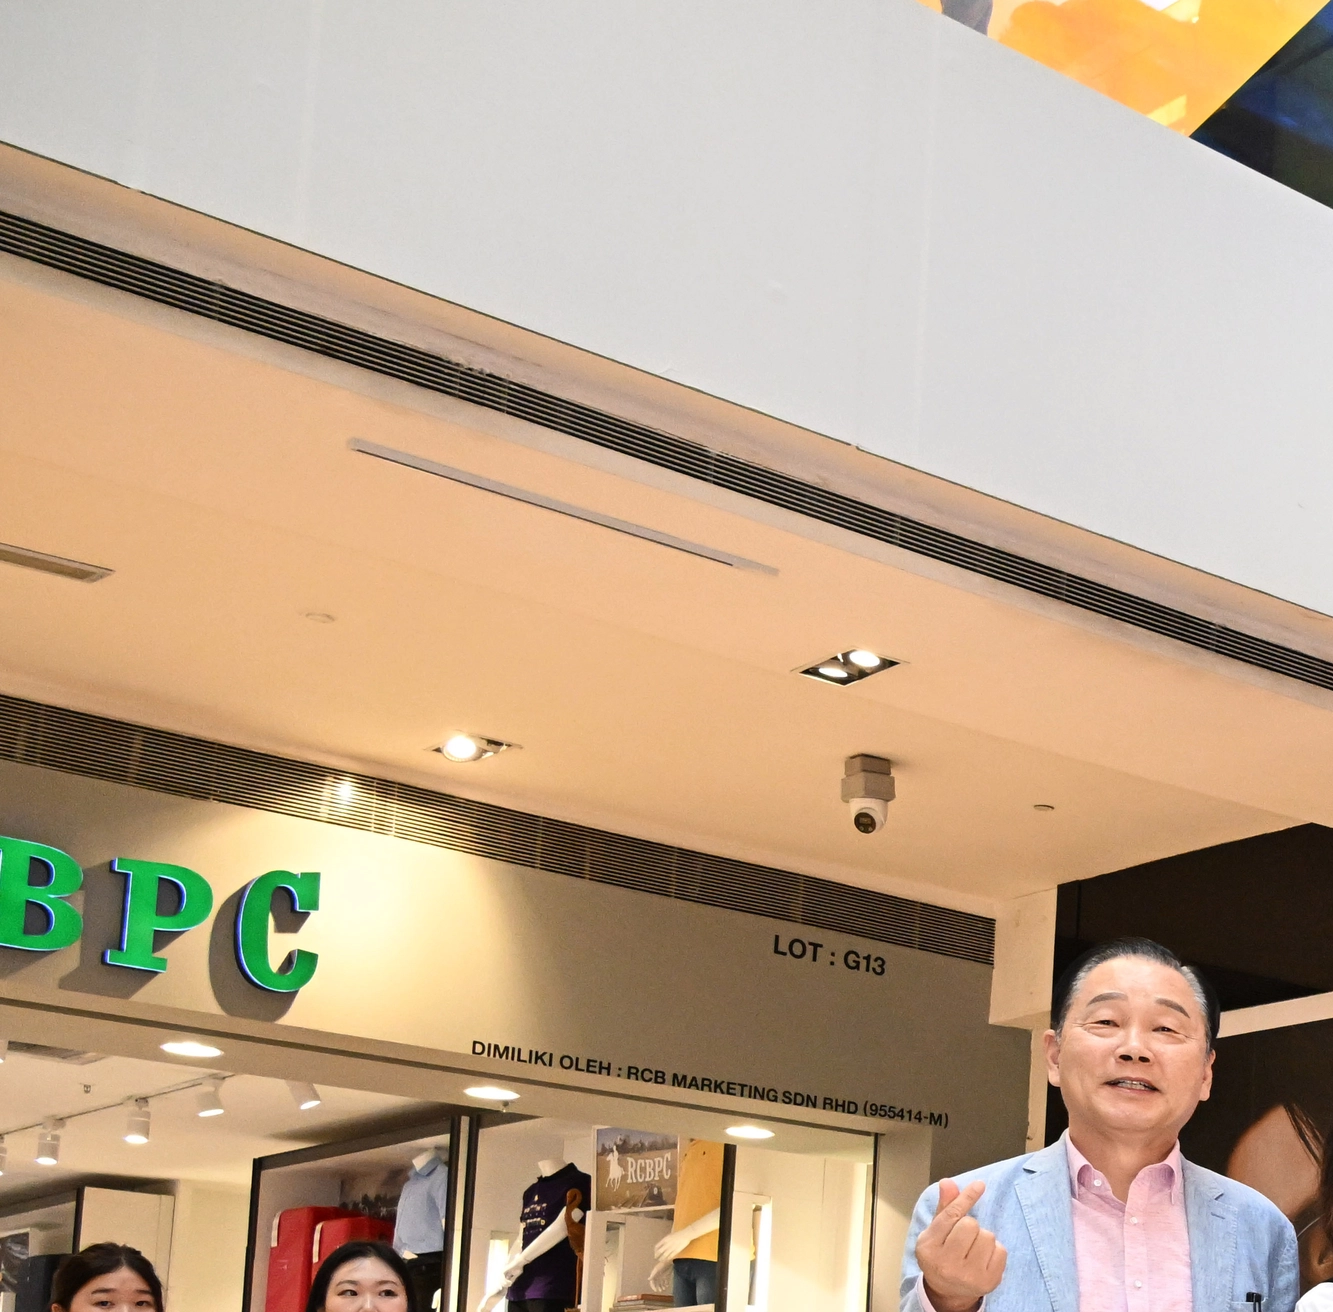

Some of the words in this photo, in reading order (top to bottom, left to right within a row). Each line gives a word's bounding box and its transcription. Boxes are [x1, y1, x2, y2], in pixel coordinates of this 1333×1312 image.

[773, 934, 826, 964] LOT
[843, 946, 887, 978] G13
[472, 1040, 553, 1067] DIMILIKI
[559, 1054, 612, 1077] OLEH
[627, 1065, 666, 1085] RCB
[671, 1072, 778, 1102] MARKETING
[782, 1091, 818, 1109] SDN
[863, 1100, 949, 1129] (955414-M)
[626, 1151, 672, 1184] RCBPC
